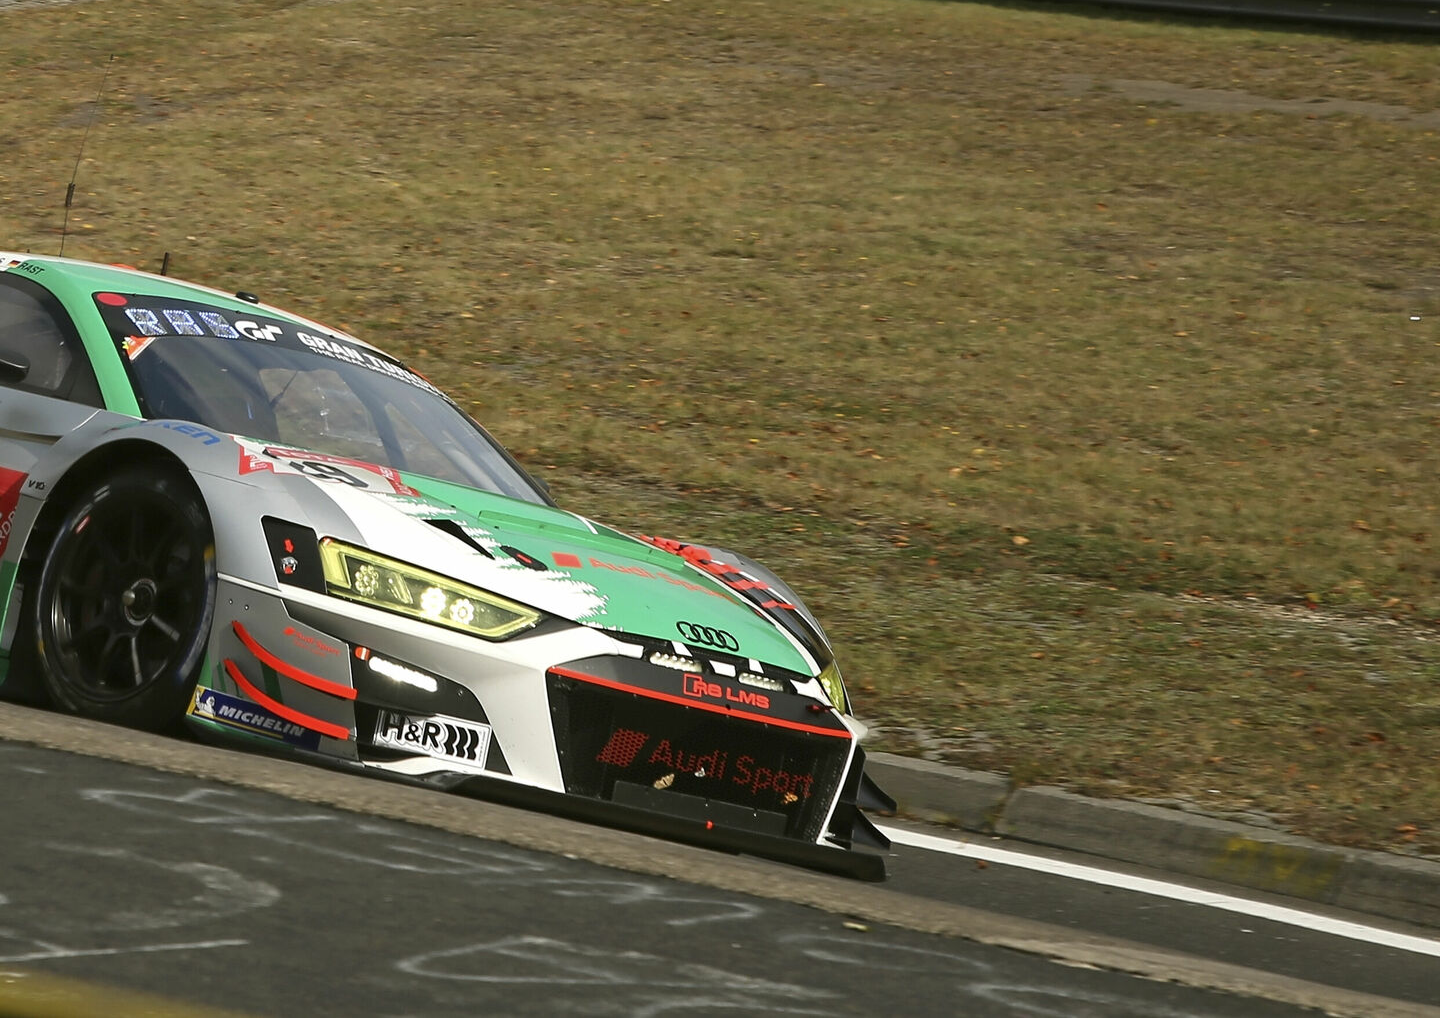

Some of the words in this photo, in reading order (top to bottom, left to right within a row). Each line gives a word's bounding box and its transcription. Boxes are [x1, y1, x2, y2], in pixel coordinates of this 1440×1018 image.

[17, 262, 46, 276] RAST
[297, 332, 364, 362] GRAN
[726, 687, 770, 710] LMS
[218, 704, 305, 737] MICHELIN
[381, 712, 441, 750] H&R
[648, 738, 728, 780] Audi
[732, 754, 814, 797] Sport
